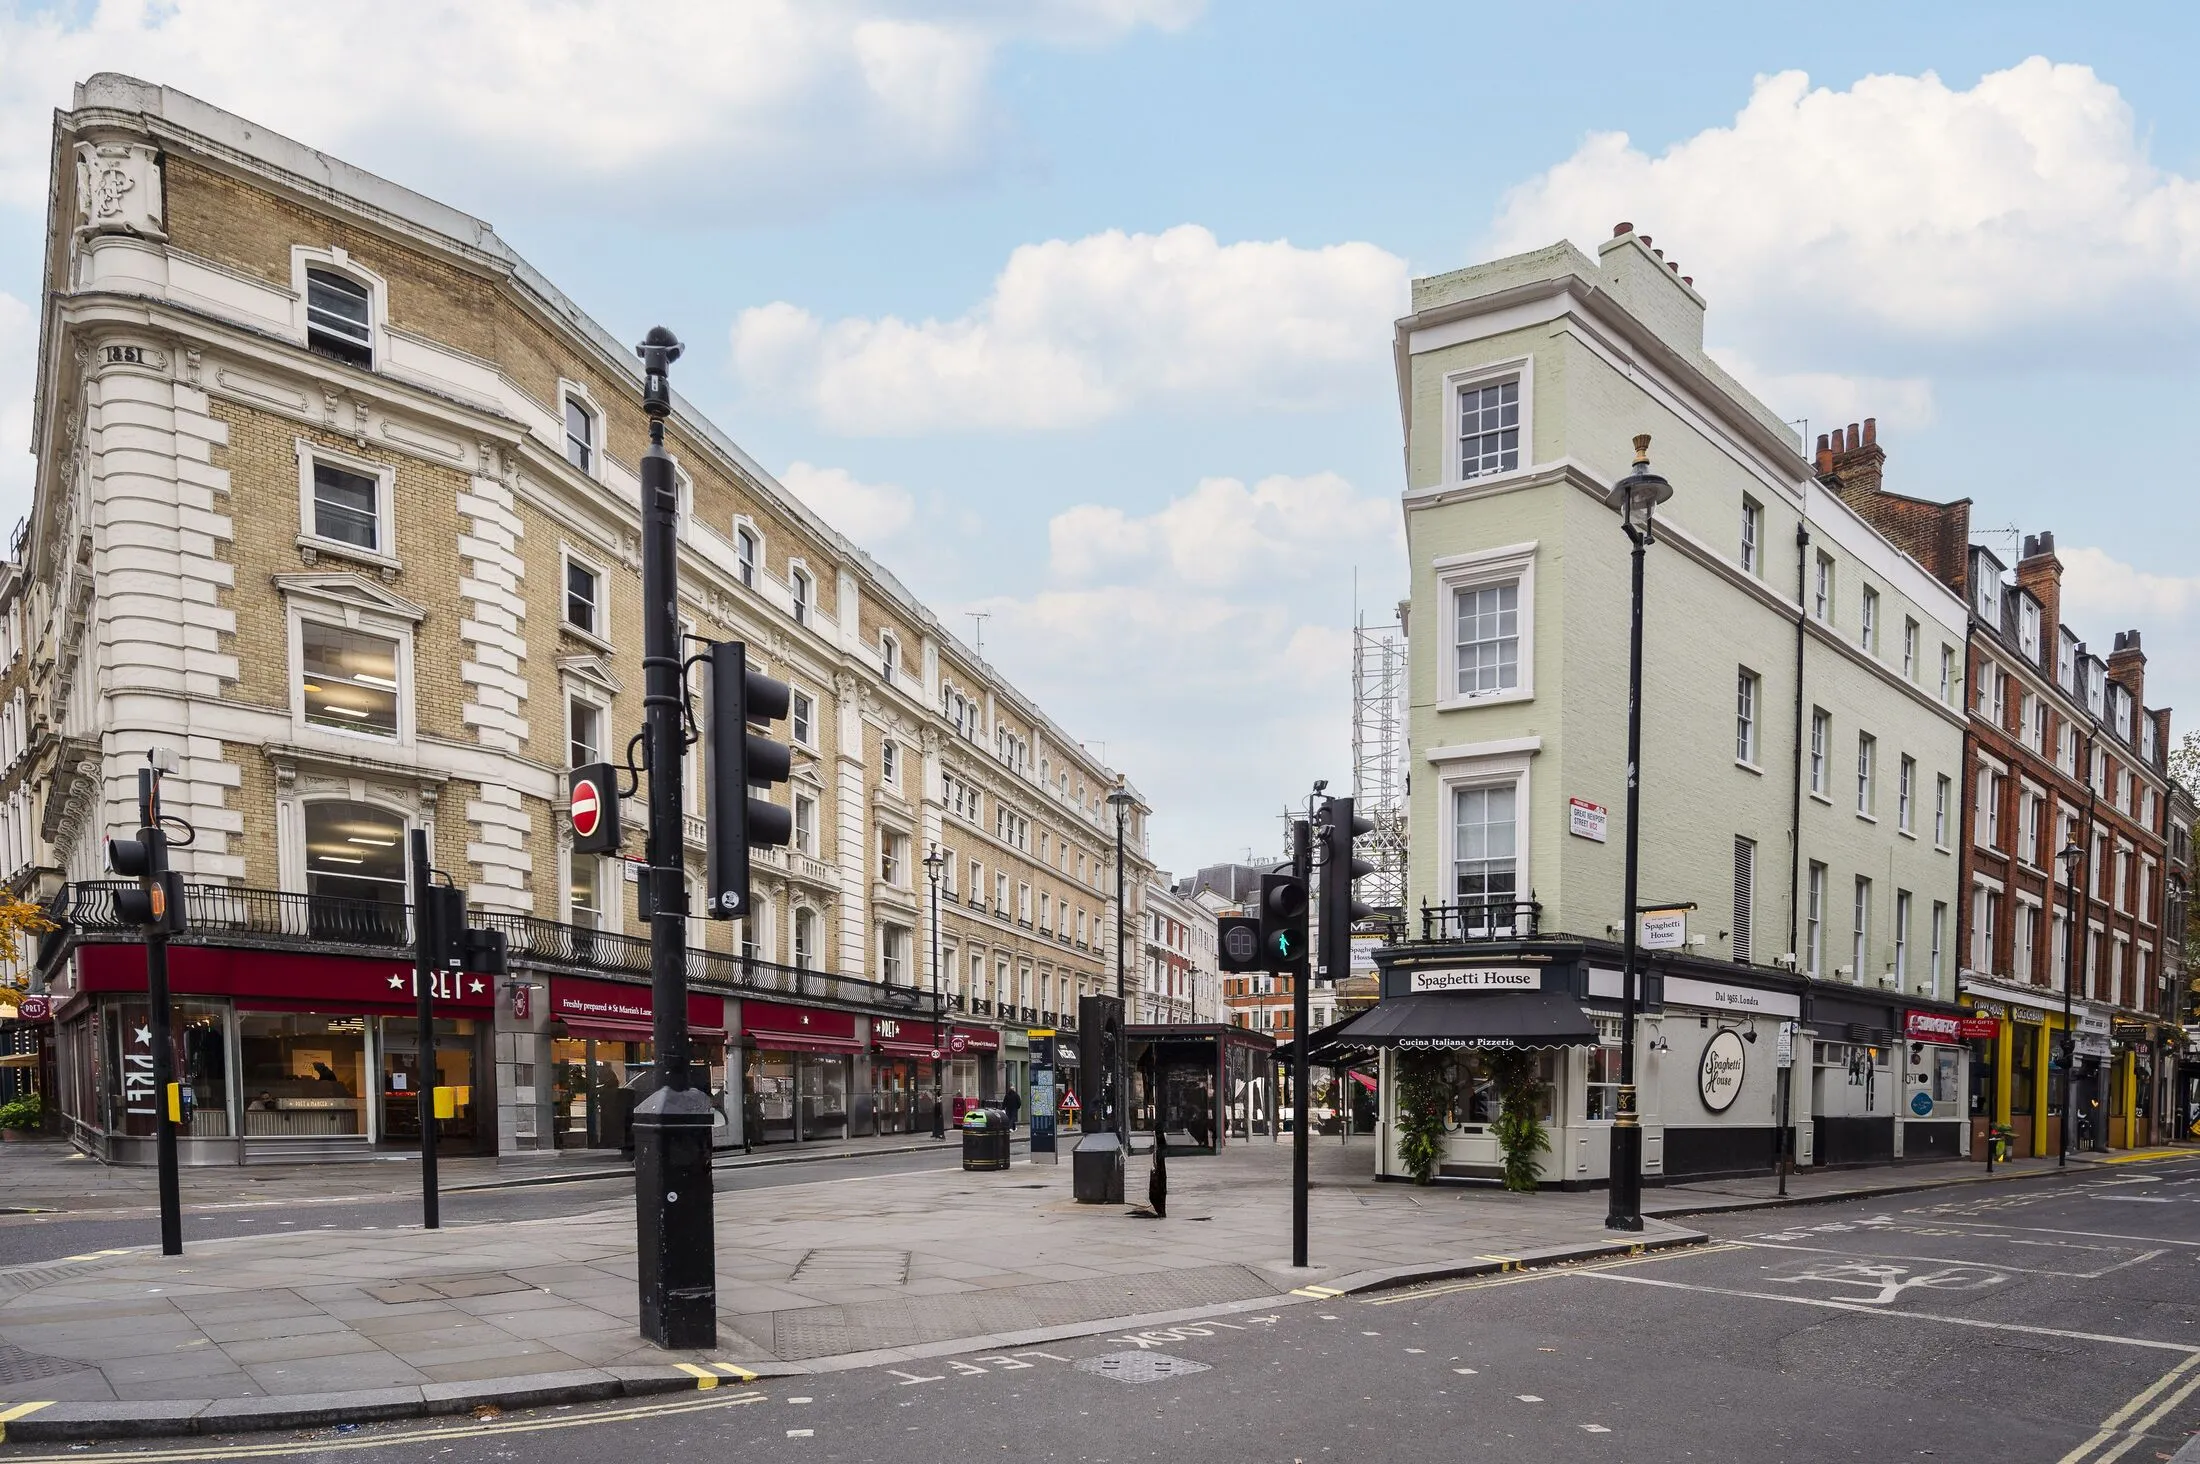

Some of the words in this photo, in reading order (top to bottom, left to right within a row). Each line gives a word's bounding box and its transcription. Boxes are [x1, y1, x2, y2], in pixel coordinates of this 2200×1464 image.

[1574, 817, 1588, 828] STREET
[1587, 812, 1605, 823] NEWPORT
[1645, 921, 1680, 931] Spaghetti
[1418, 973, 1478, 989] Spaghetti
[1483, 972, 1531, 984] House
[1715, 991, 1725, 1002] Dal
[25, 1004, 41, 1013] PRET
[563, 999, 583, 1011] Freshly
[584, 1003, 607, 1013] prepared
[613, 1004, 619, 1013] St
[640, 1007, 652, 1016] Lane
[881, 1020, 895, 1038] PRET
[1918, 1016, 1936, 1031] STAR
[1936, 1018, 1954, 1033] GIFTS
[1399, 1038, 1429, 1046] Cucina
[1432, 1038, 1466, 1046] Italiana
[1477, 1038, 1514, 1046] Pizzeria
[1705, 1050, 1741, 1074] Spaghetti
[1705, 1070, 1732, 1093] House
